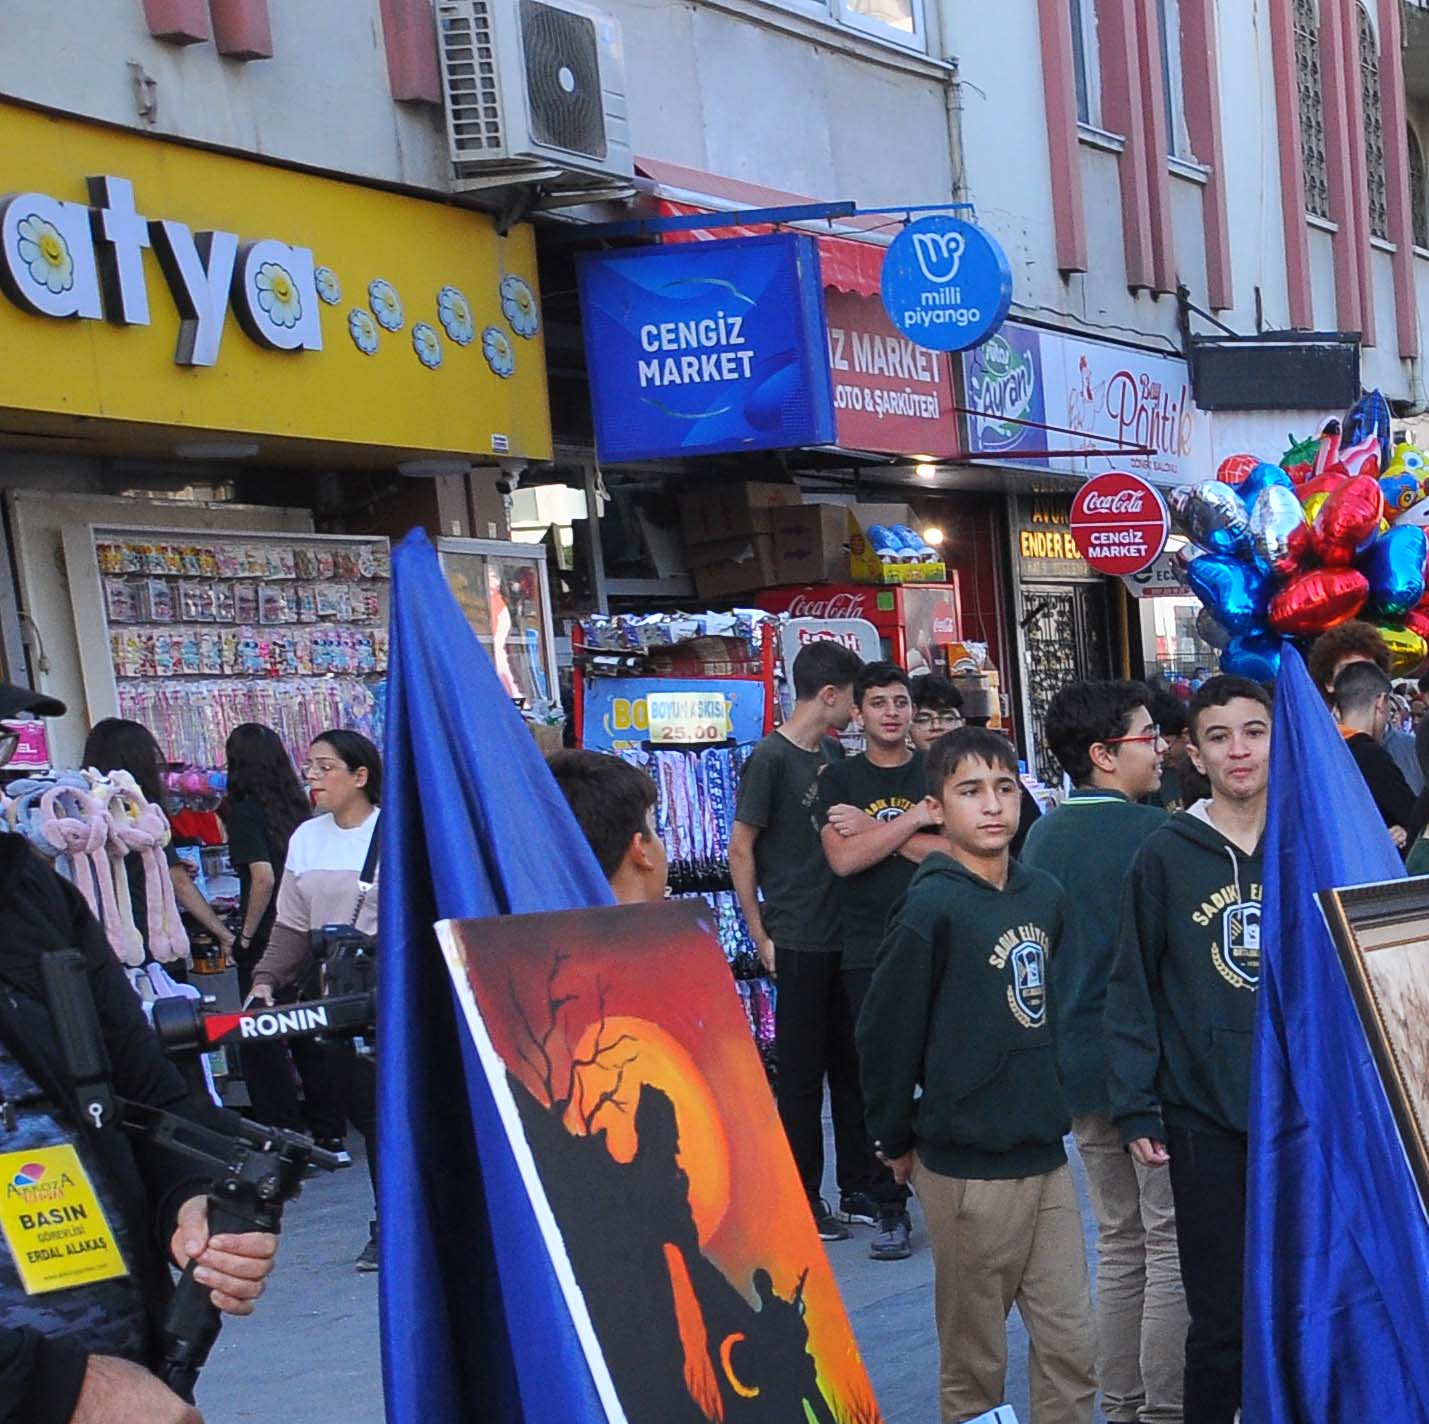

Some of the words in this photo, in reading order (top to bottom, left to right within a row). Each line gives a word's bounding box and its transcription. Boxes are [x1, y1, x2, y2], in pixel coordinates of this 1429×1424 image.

[920, 287, 961, 305] milli
[904, 306, 981, 328] piyango
[640, 310, 745, 353] CENGİZ
[637, 350, 754, 388] MARKET
[852, 331, 940, 384] MARKET
[834, 384, 863, 408] OTO
[864, 391, 875, 412] &
[874, 386, 940, 419] ŞARKÜTERİ
[1082, 489, 1146, 515] Coca-Cola
[1020, 530, 1064, 560] ENDER
[1090, 528, 1143, 545] CENGİZ
[1088, 545, 1148, 559] MARKET
[1191, 884, 1240, 926] SADIK
[240, 1006, 329, 1039] RONIN
[19, 1203, 88, 1230] BASIN
[26, 1247, 63, 1264] ERDAL
